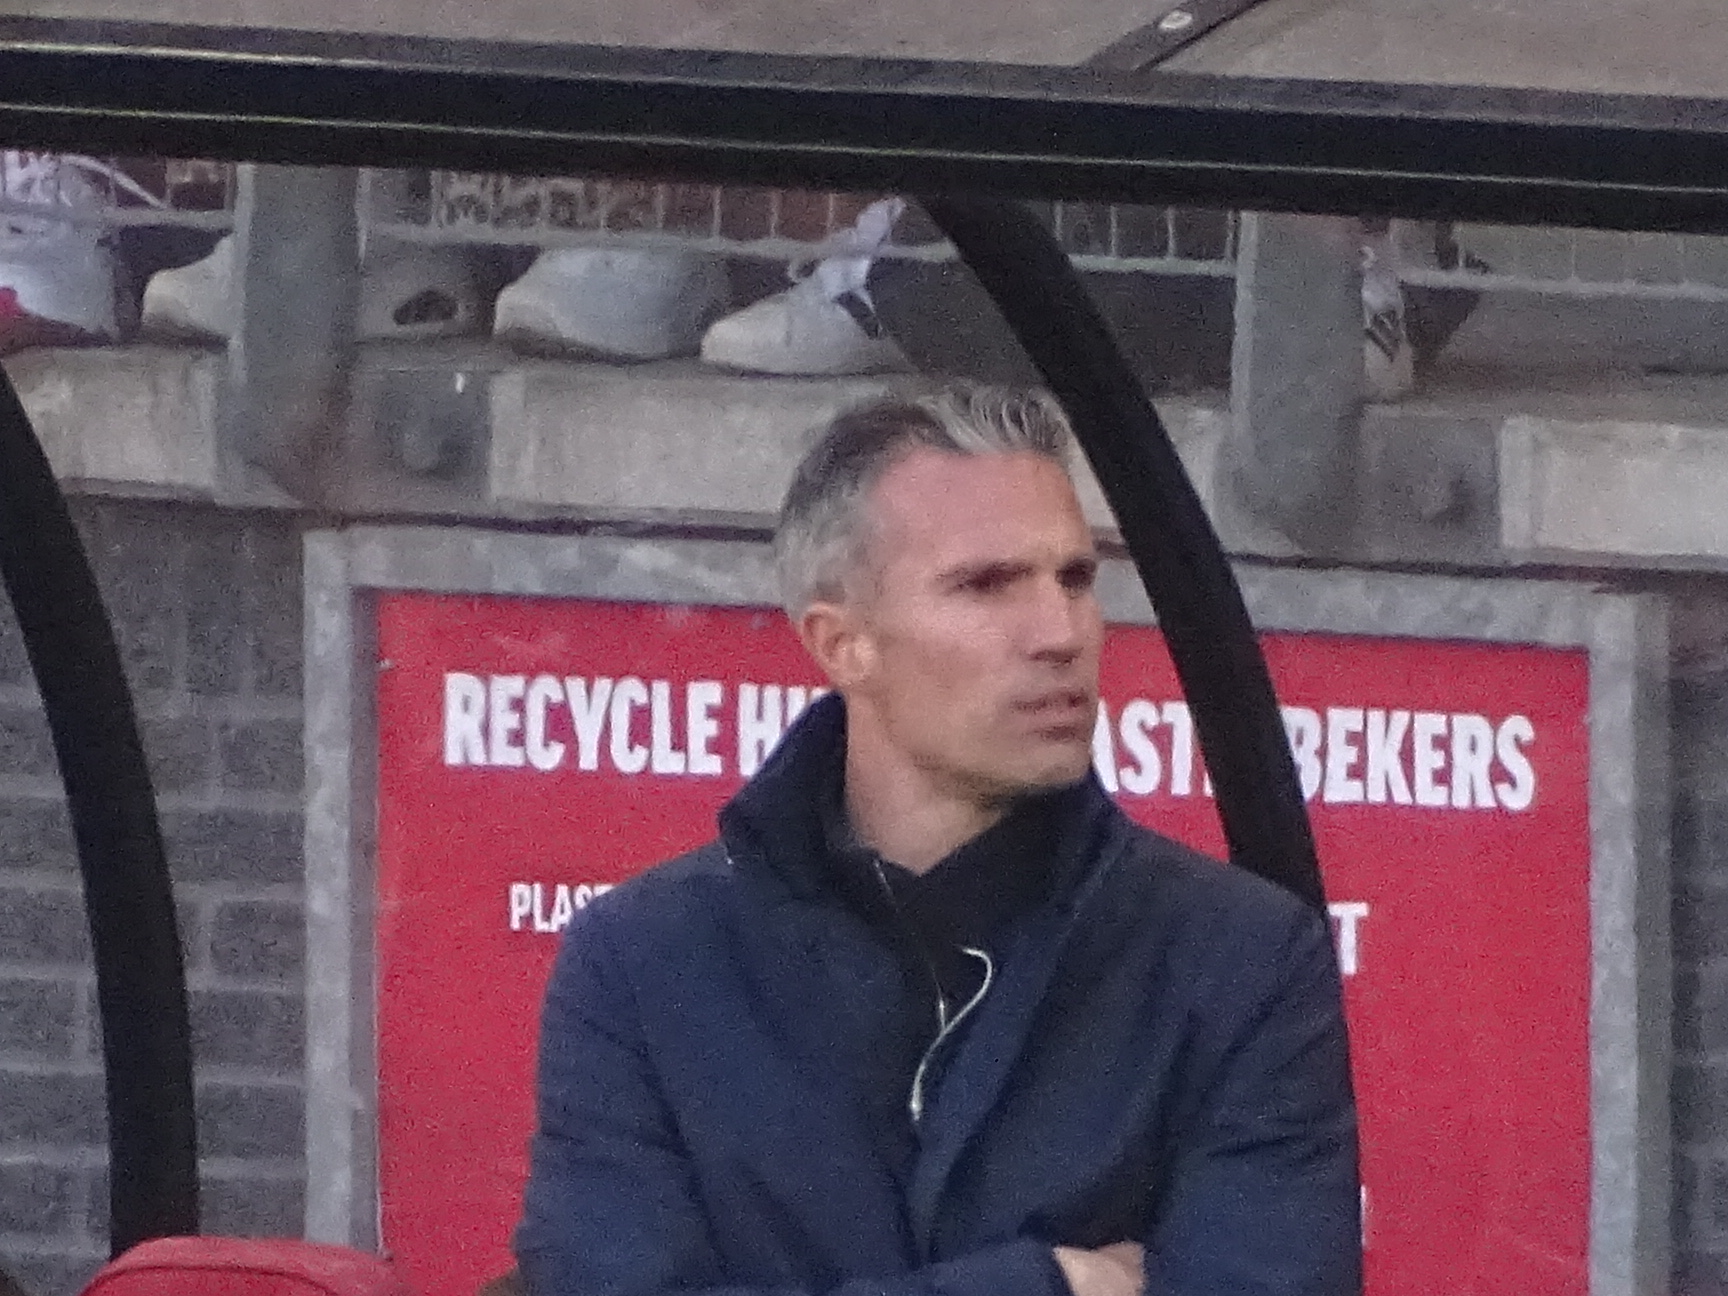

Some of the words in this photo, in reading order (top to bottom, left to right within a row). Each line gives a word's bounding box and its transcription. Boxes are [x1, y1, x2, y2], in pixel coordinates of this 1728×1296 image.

[444, 672, 724, 776] RECYCLE
[1281, 705, 1536, 811] BEKERS
[508, 881, 614, 933] PLA
